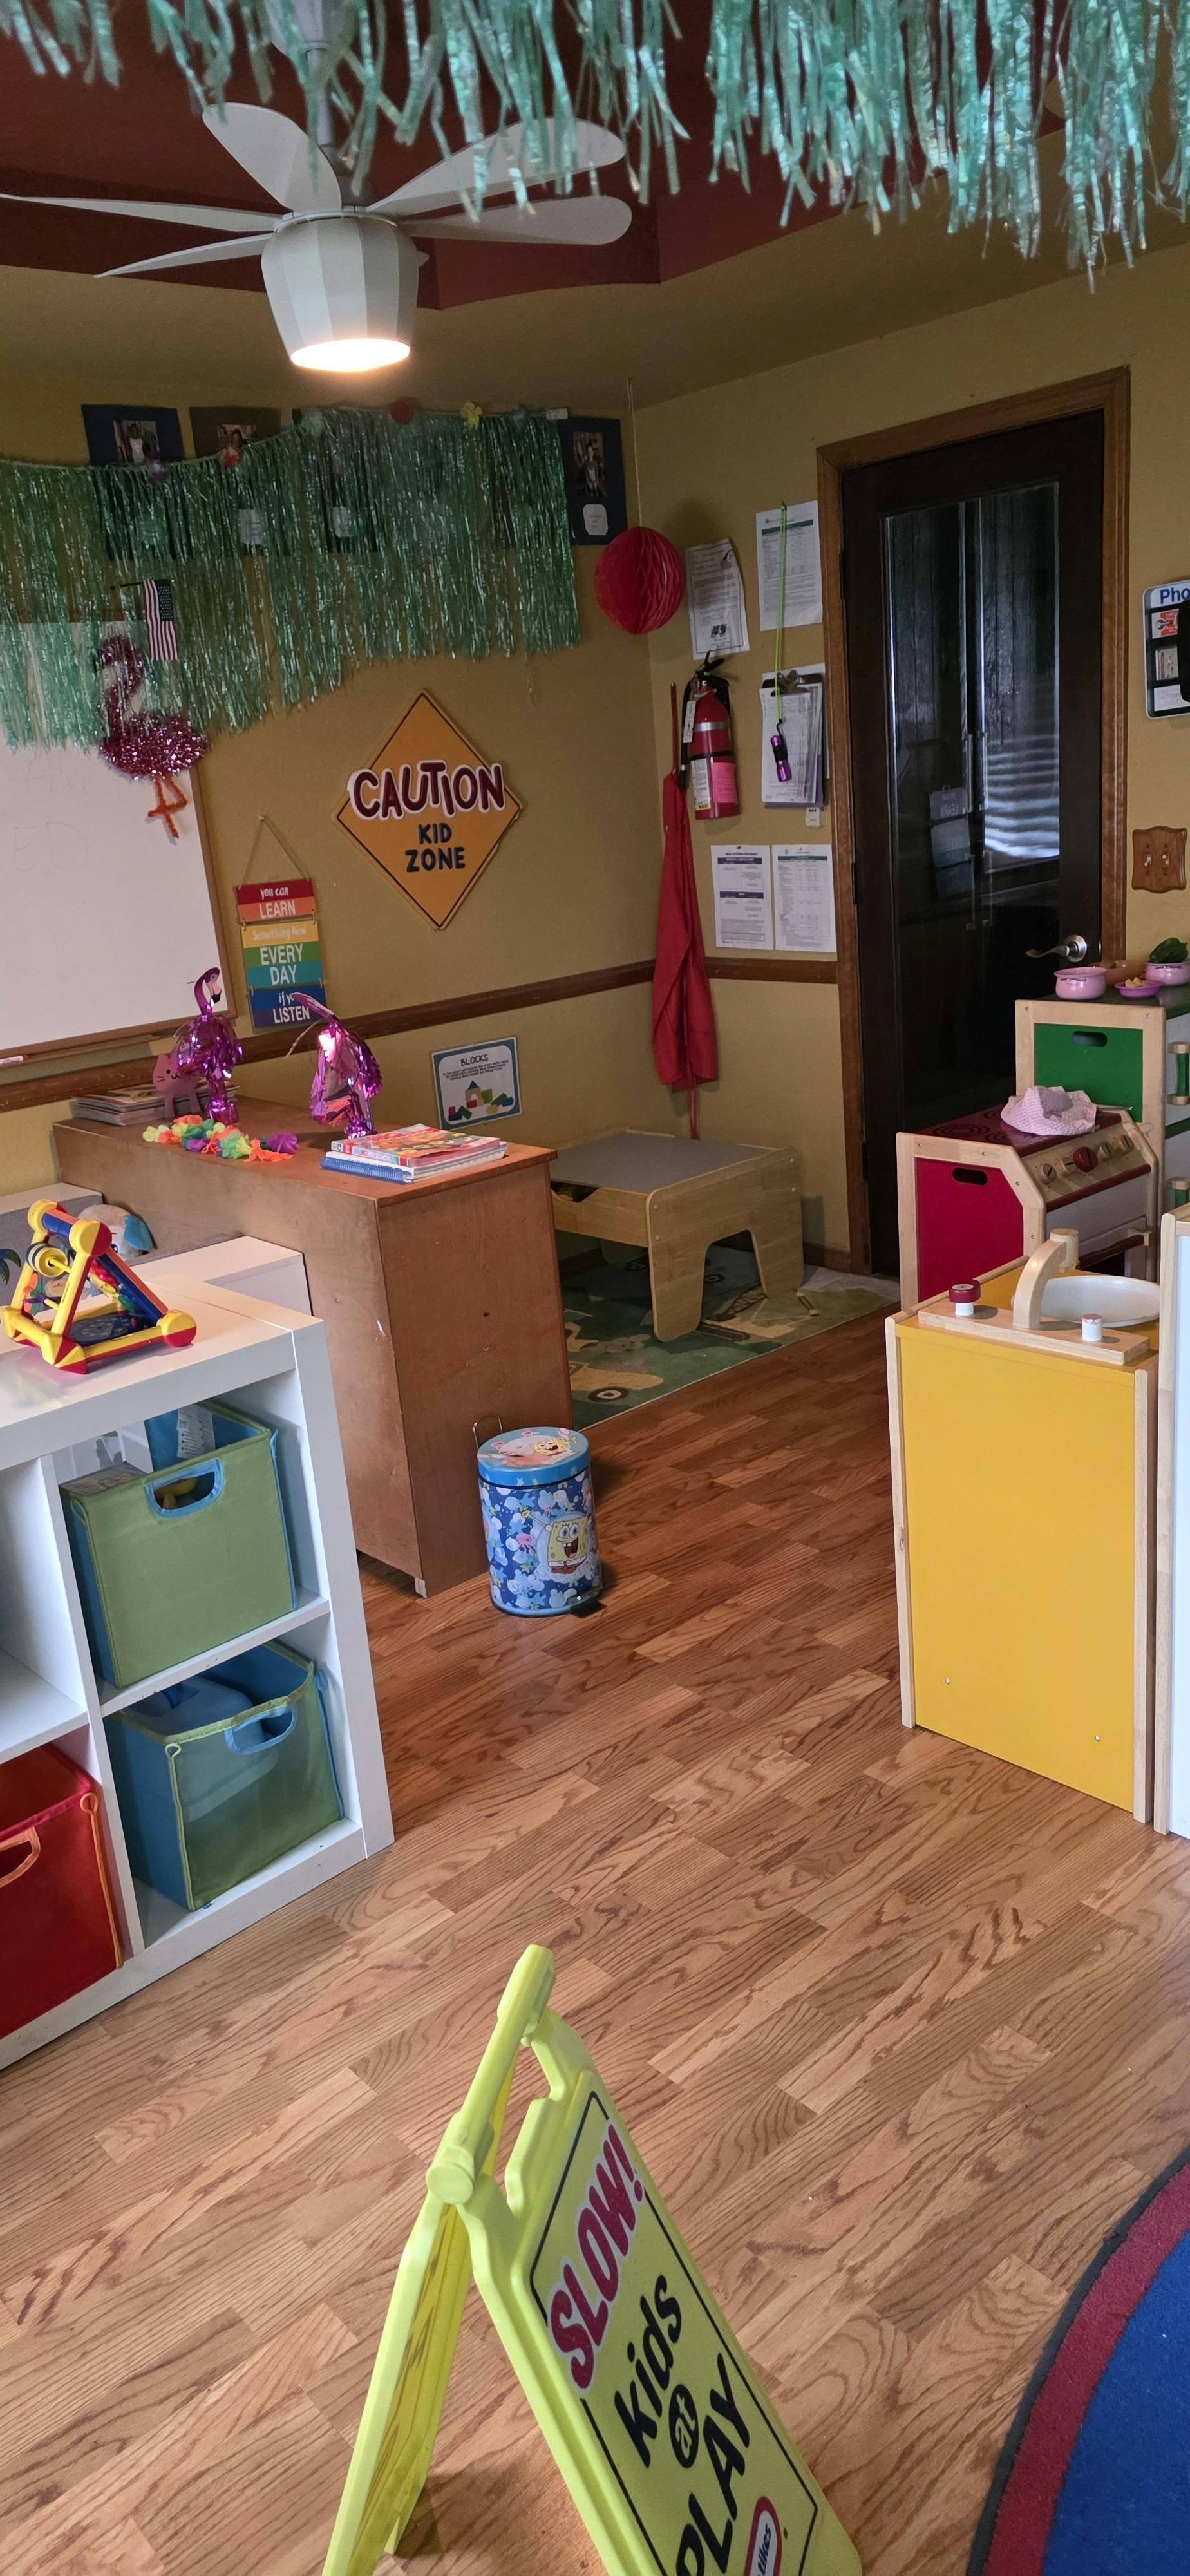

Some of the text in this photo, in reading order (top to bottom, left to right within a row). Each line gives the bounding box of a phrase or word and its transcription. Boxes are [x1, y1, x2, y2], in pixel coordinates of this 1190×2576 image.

[354, 762, 505, 818] CAUTION
[418, 822, 451, 844] KID
[405, 846, 466, 873] ZONE
[260, 887, 289, 900] you can
[259, 900, 296, 919] LEARN
[260, 943, 303, 965] EVERY
[270, 965, 298, 986] DAY
[278, 991, 285, 1006] if
[272, 1005, 310, 1024] LISTEN
[460, 1054, 489, 1066] BLOCKS
[551, 2124, 643, 2390] SLOW!
[614, 2275, 681, 2468] kids
[675, 2392, 697, 2451] at
[758, 2521, 772, 2576] tikes
